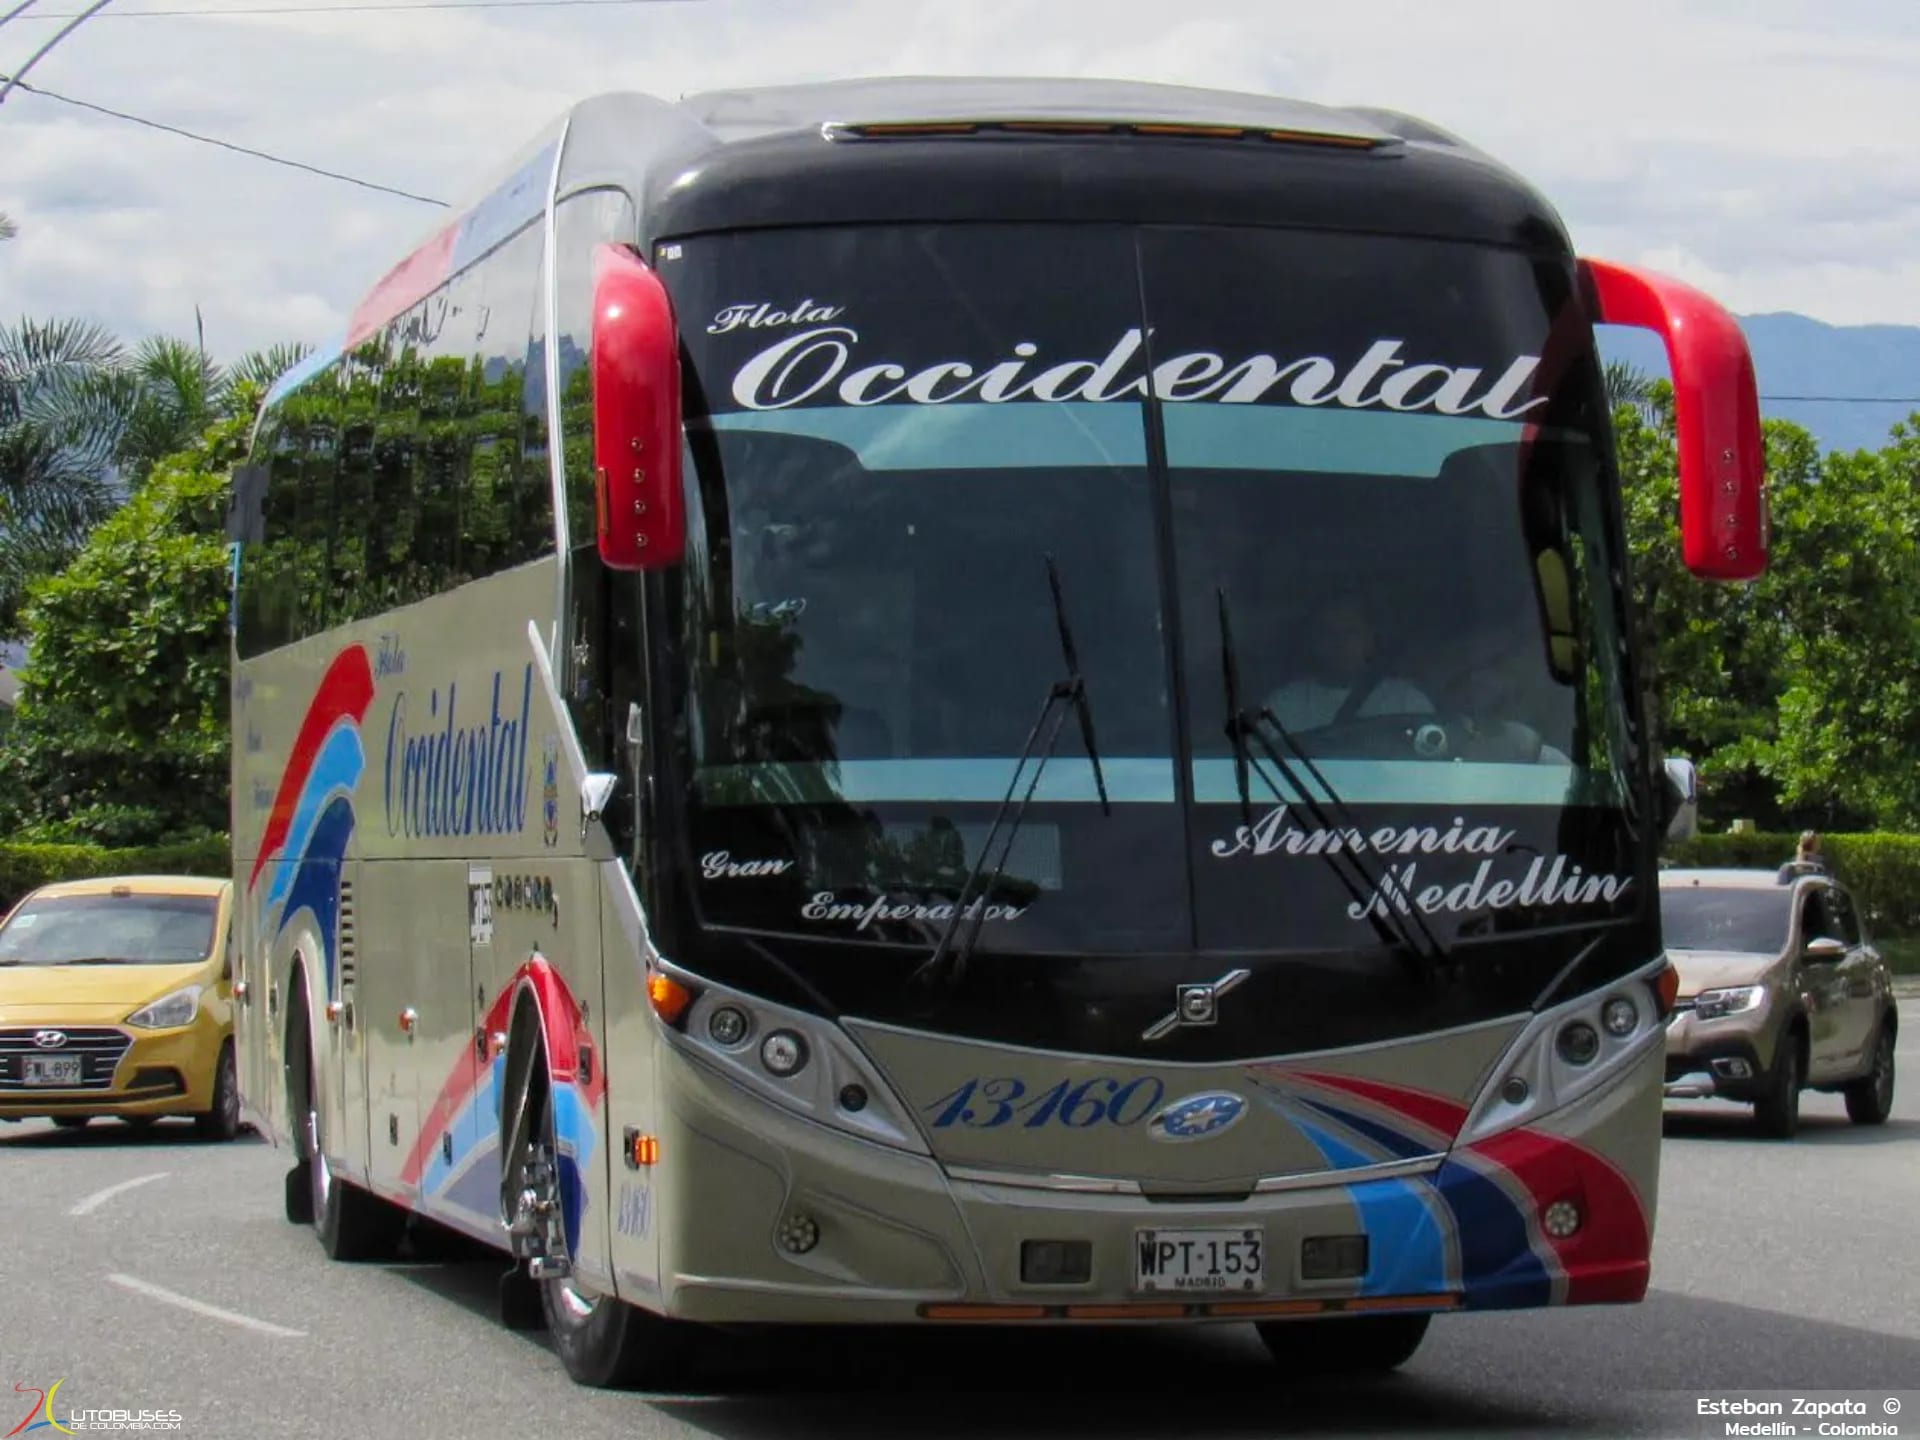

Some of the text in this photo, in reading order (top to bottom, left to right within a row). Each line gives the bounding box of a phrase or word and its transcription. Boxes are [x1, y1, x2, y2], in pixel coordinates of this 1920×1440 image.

[707, 299, 845, 334] Flota
[732, 327, 1549, 419] Occidental
[384, 662, 532, 839] Occidental
[1211, 804, 1517, 857] Armenia
[701, 851, 794, 879] Gran
[1347, 855, 1633, 920] Medellin
[924, 1076, 1165, 1128] 13160
